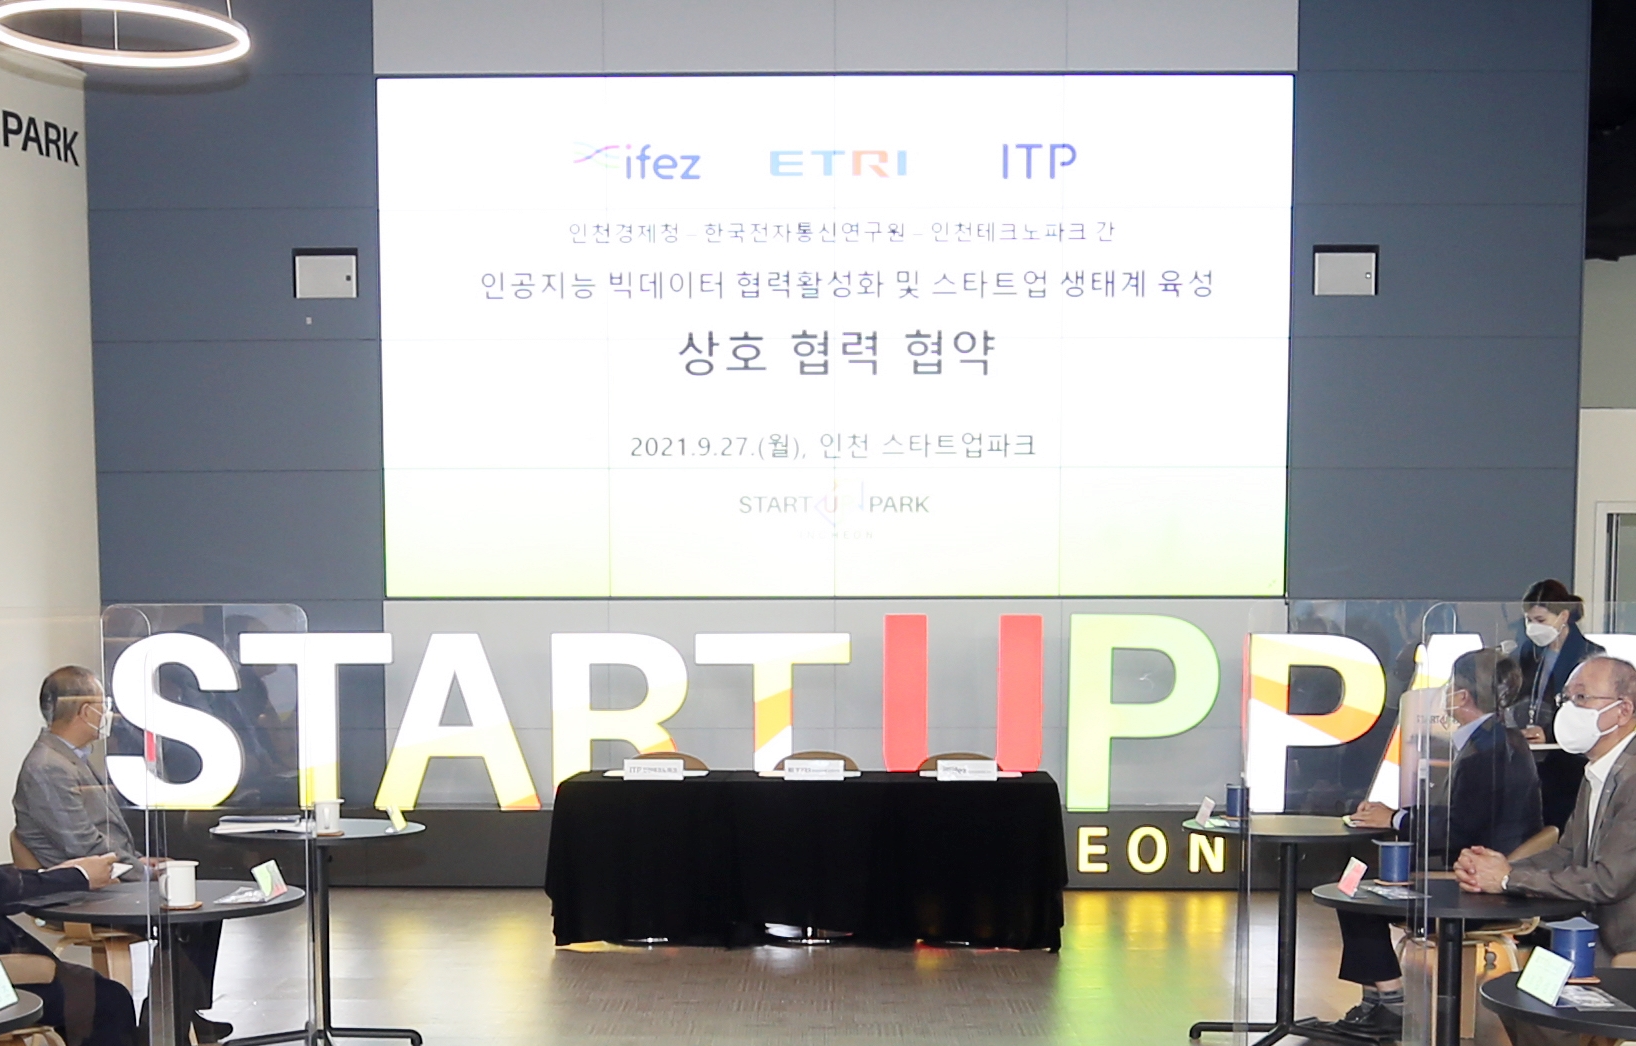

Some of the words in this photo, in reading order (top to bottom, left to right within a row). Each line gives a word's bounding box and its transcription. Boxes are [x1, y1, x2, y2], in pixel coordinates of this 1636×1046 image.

[1, 110, 80, 167] PARK
[624, 143, 702, 180] ifez
[769, 149, 907, 178] ETRI
[1001, 143, 1078, 180] ITP
[569, 221, 680, 244] 인천경제청
[705, 221, 906, 245] 한국전자통신연구원
[931, 221, 1088, 245] 인천테크노파크
[1096, 221, 1116, 244] 간
[480, 271, 597, 300] 인공지능
[608, 270, 724, 300] 빅데이터
[736, 270, 885, 300] 협력활성화
[896, 270, 920, 299] 및
[931, 270, 1048, 299] 스타트업
[1060, 269, 1146, 298] 생태계
[1157, 269, 1214, 298] 육성
[677, 330, 768, 377] 상호
[790, 329, 879, 376] 협력
[904, 328, 997, 376] 협약
[630, 432, 807, 461] 2021.9.27.(월),
[819, 432, 870, 460] 인천
[881, 432, 1037, 459] 스타트업파크
[739, 495, 814, 514] START
[868, 495, 931, 513] PARK
[106, 632, 852, 812] START
[882, 612, 1223, 814] UP
